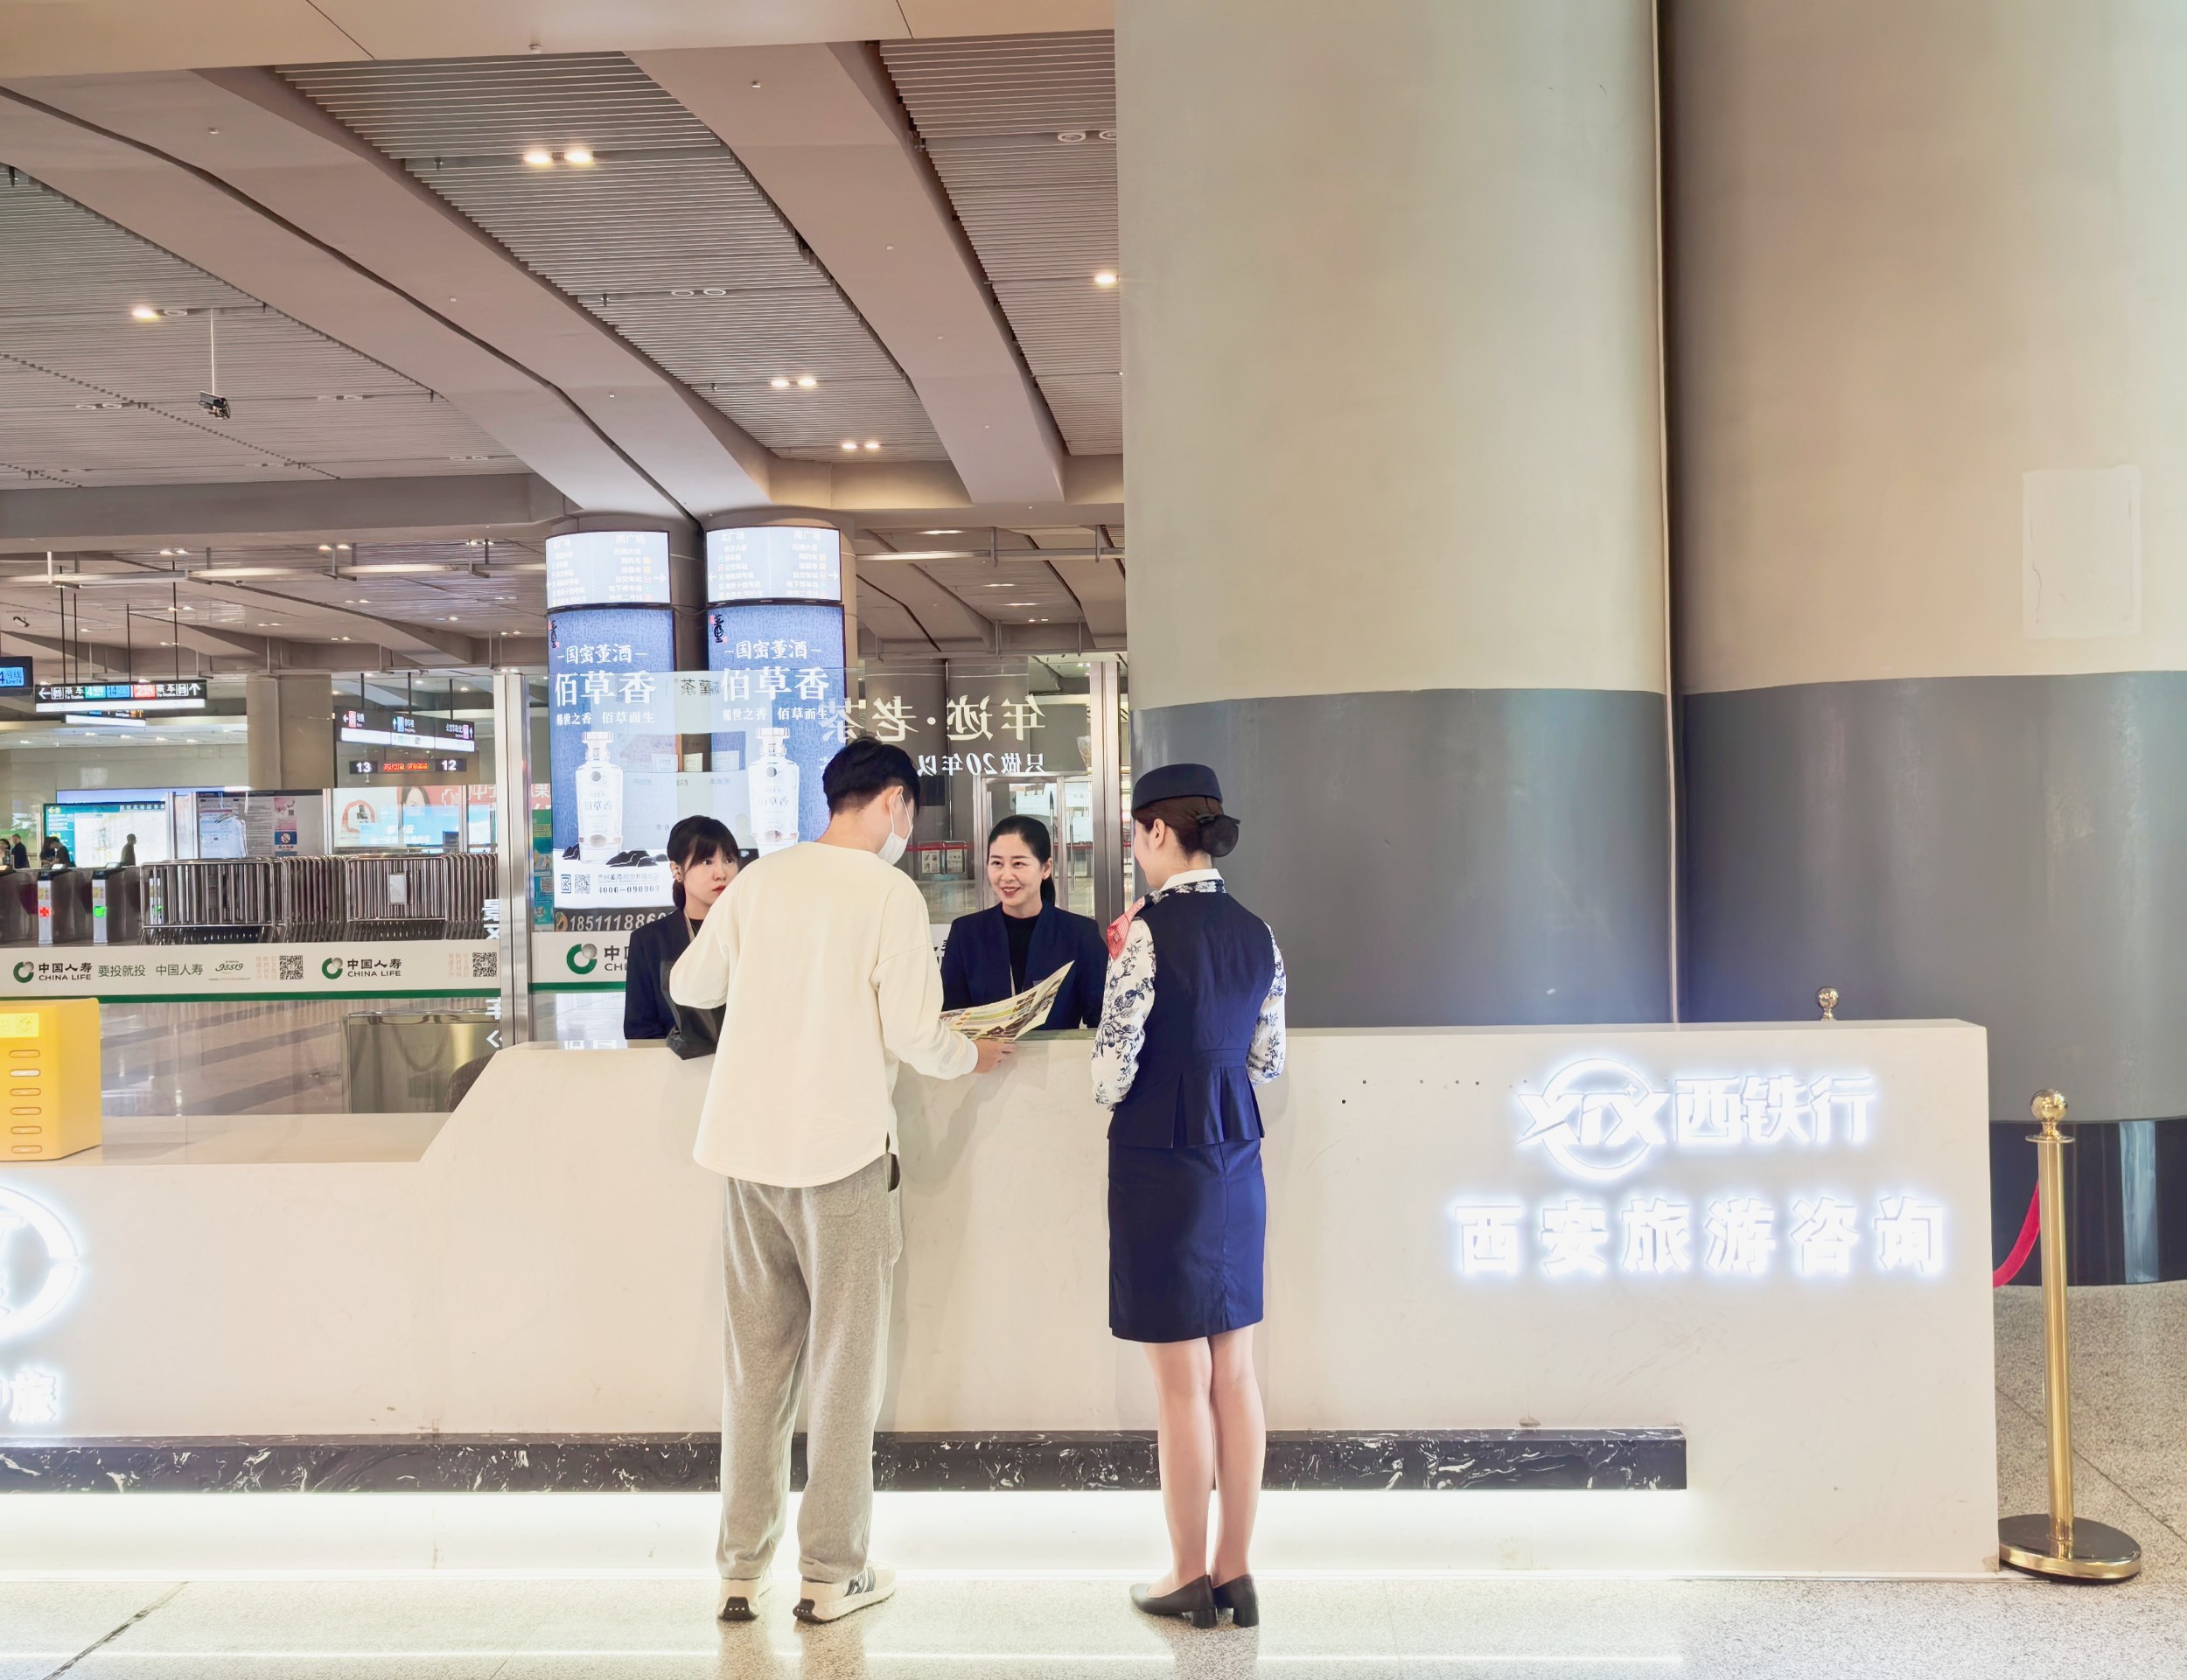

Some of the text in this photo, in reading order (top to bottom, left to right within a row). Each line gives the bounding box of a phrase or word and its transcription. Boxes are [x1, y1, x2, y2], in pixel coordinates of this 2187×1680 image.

[566, 643, 633, 665] 国密董酒
[736, 638, 808, 660] 国密董酒
[555, 669, 657, 708] 佰草香
[720, 666, 829, 703] 佰草香
[602, 710, 655, 725] 佰草而生
[356, 762, 372, 773] 13
[442, 759, 457, 771] 12
[598, 884, 660, 895] 4006-090909
[569, 911, 674, 931] 185111886
[38, 962, 93, 973] 中国人寿
[98, 965, 146, 977] 要投就投
[156, 964, 204, 977] 中国人寿
[215, 963, 244, 972] 95519
[346, 958, 402, 971] 中国人寿
[1673, 1074, 1877, 1144] 西铁行
[1453, 1195, 1945, 1276] 西安旅游咨询
